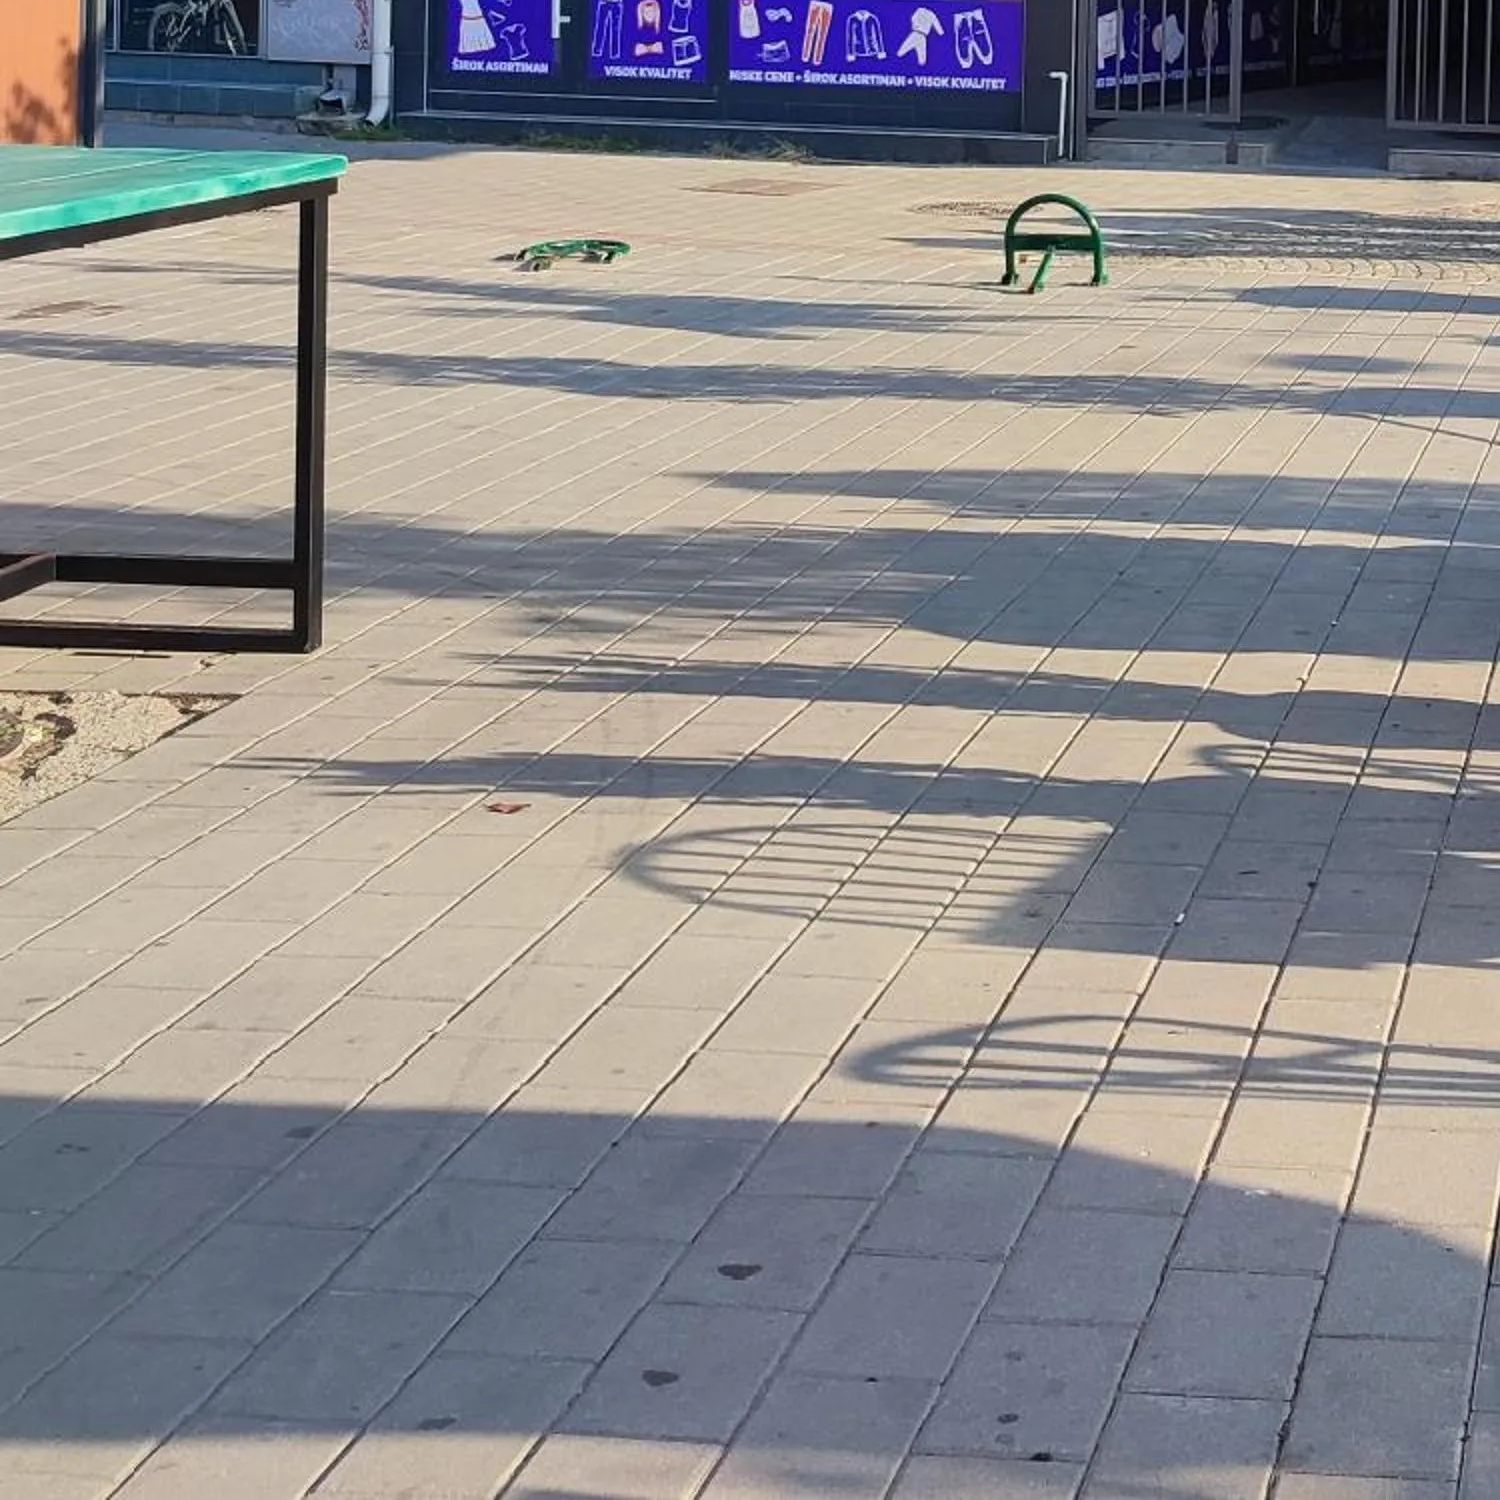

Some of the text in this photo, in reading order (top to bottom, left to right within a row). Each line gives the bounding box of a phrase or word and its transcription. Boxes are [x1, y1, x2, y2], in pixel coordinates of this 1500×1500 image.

[604, 65, 693, 80] VISOK KVALITET
[915, 75, 949, 88] VISOK
[951, 77, 1006, 90] KVALITET
